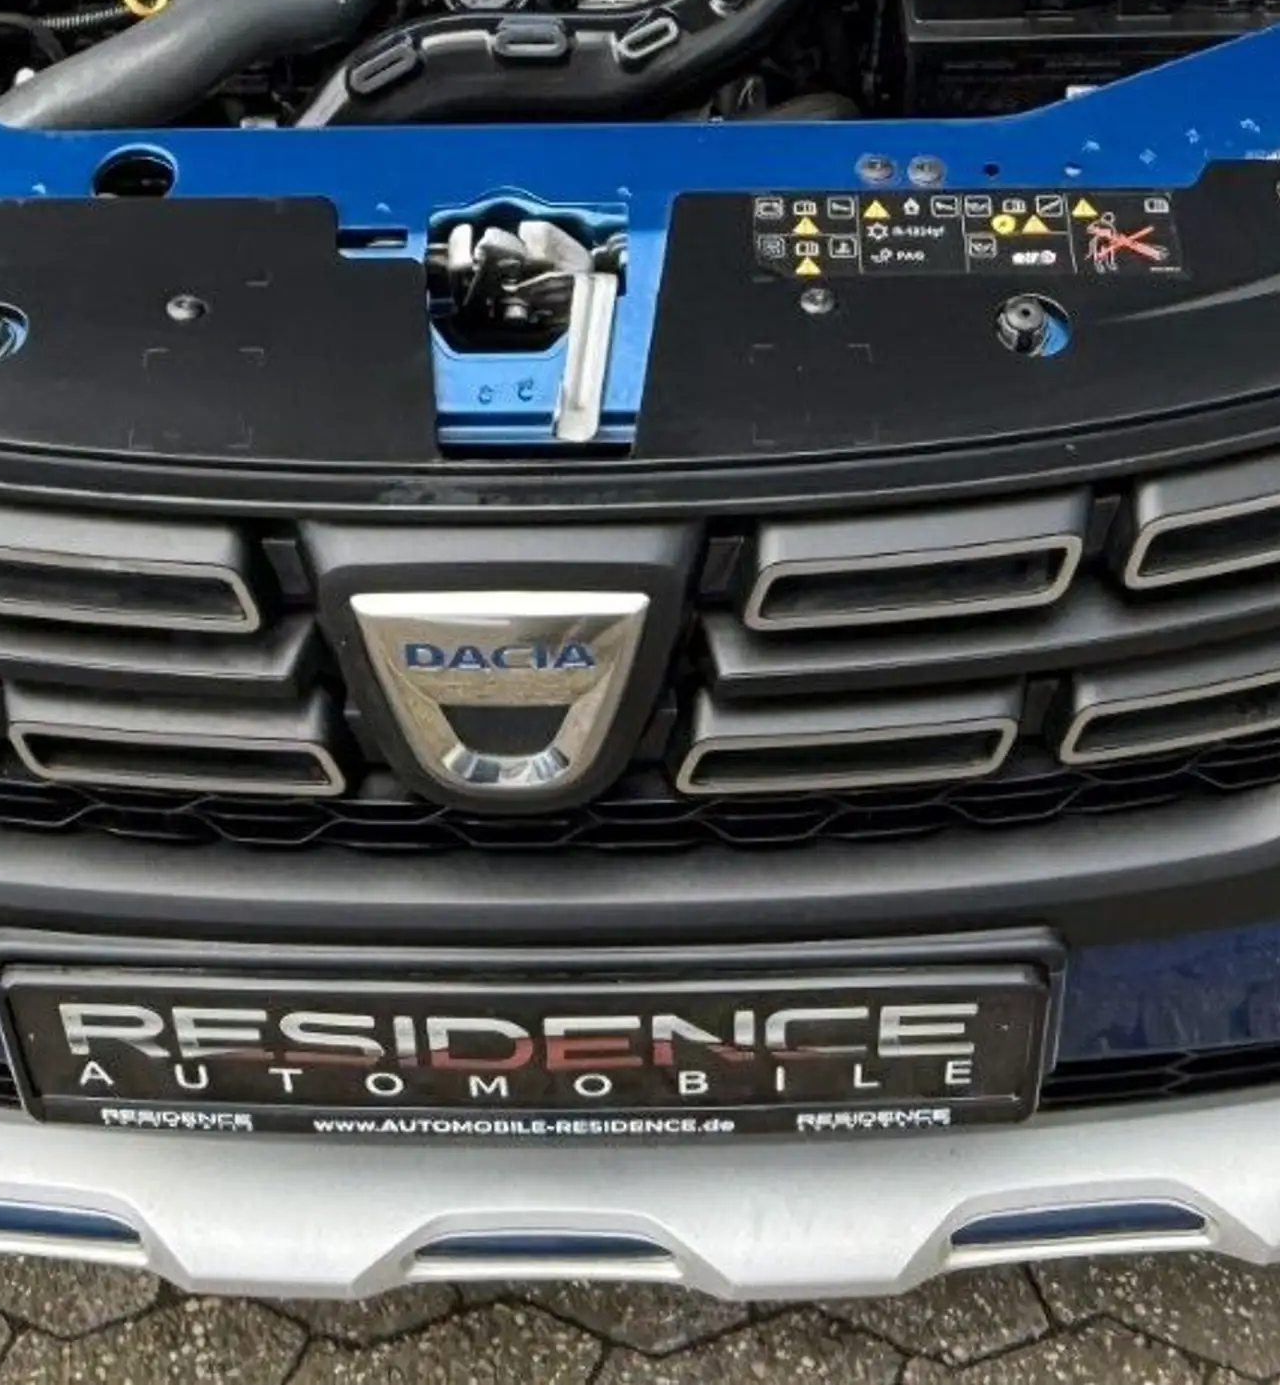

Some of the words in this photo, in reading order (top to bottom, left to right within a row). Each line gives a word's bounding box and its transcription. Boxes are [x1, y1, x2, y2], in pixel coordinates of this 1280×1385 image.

[404, 642, 596, 671] DACIA
[58, 1002, 979, 1072] RESIDENCE
[79, 1060, 974, 1099] AUTOMOBILE
[313, 1117, 736, 1135] www.AUTOMOBILE-RESIDENCE.de
